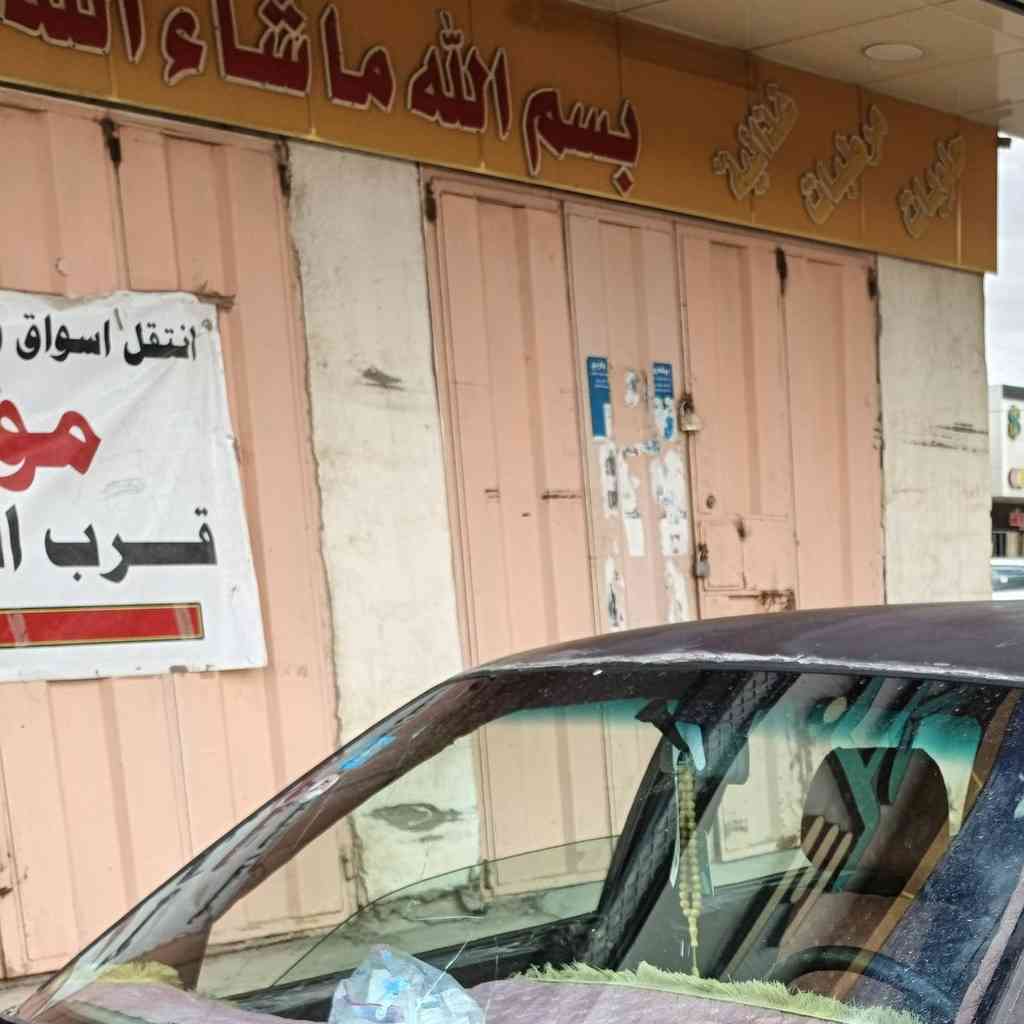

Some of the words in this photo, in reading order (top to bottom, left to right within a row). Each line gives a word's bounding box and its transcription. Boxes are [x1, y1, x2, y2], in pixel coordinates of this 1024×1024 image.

[407, 8, 512, 140] الله
[522, 87, 640, 197] بسم
[16, 312, 111, 362] اسواق
[123, 321, 197, 366] انتقل
[44, 506, 218, 583] قرب
